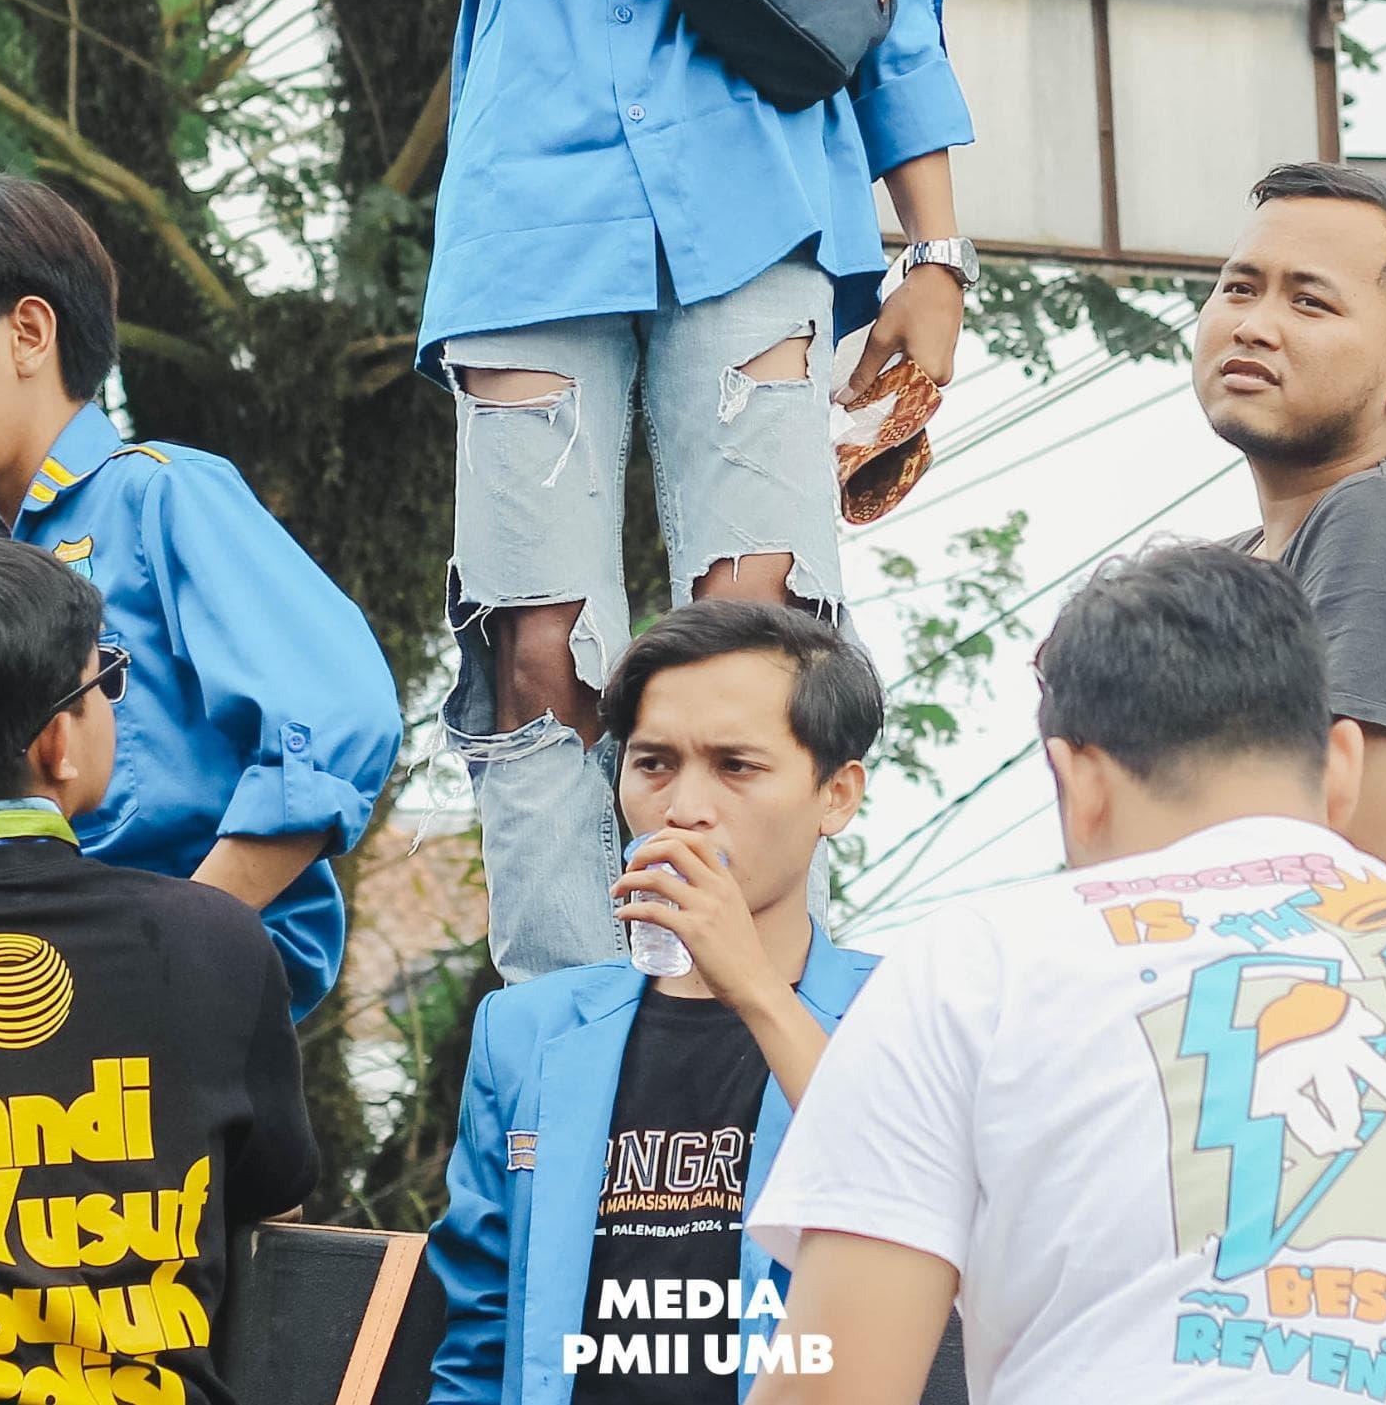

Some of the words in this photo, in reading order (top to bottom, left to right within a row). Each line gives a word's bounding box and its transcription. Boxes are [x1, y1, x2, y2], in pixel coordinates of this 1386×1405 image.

[1074, 853, 1345, 904] SUCCESS
[1101, 899, 1195, 946] IS
[606, 1194, 690, 1216] MAHASISWA
[611, 1223, 690, 1239] PALEMBANG
[691, 1219, 723, 1233] 2024
